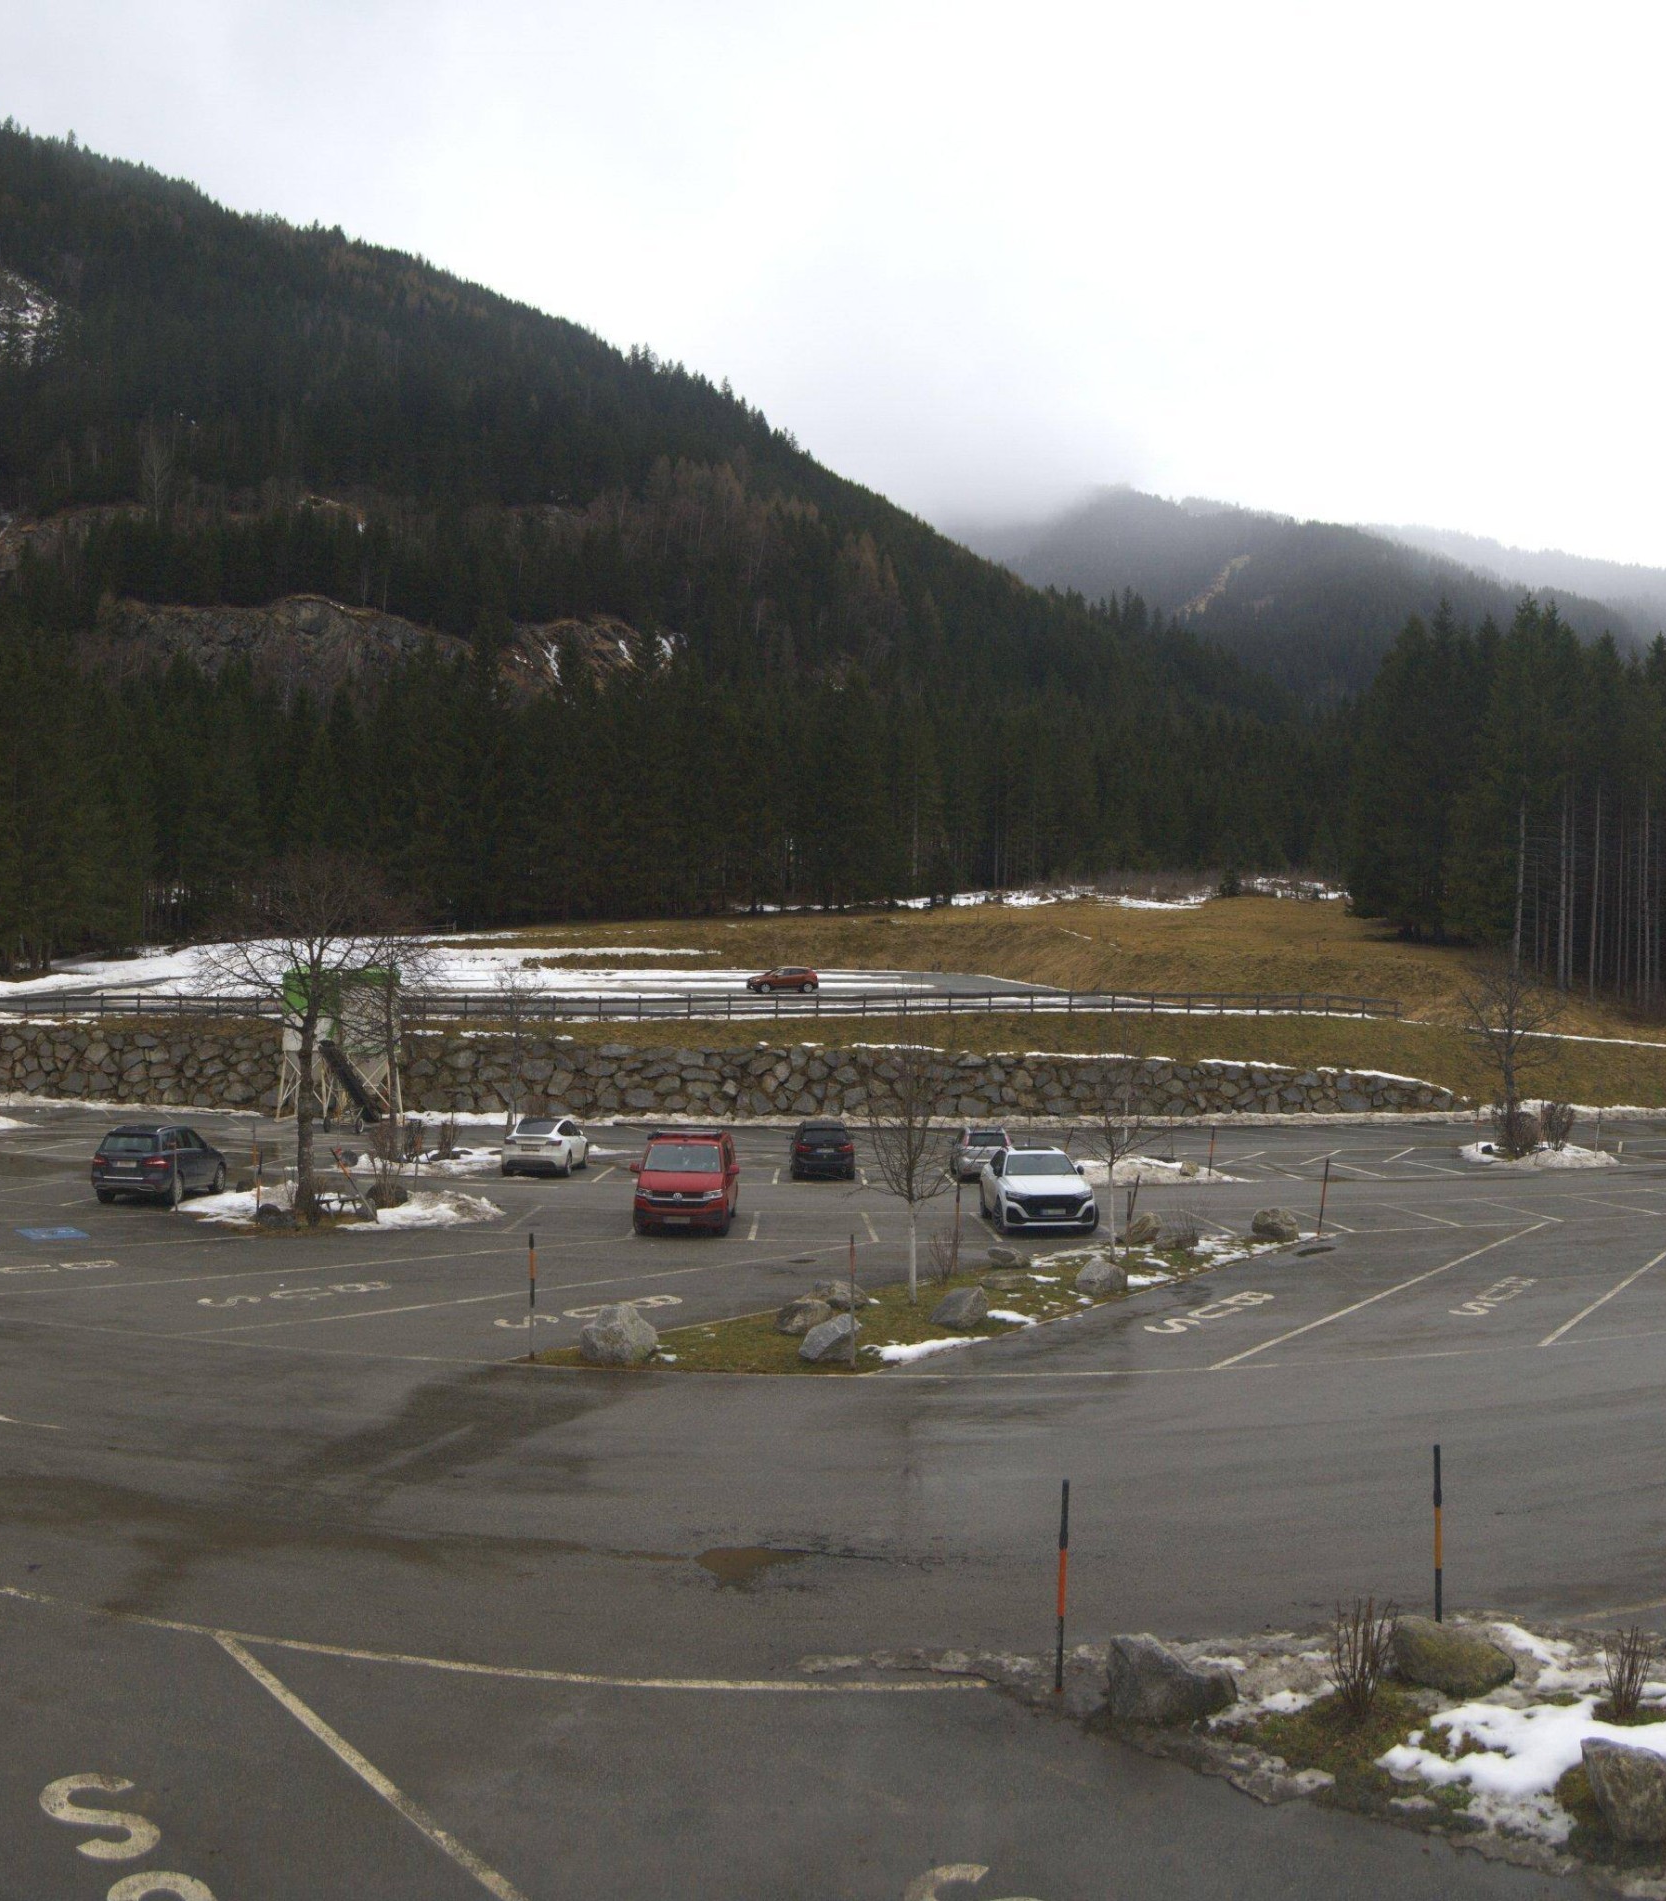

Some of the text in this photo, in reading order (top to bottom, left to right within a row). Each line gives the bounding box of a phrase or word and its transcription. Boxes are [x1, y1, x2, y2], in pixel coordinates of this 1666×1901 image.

[197, 1280, 393, 1308] BUS
[1144, 1291, 1275, 1334] BUS
[1448, 1276, 1538, 1316] BUS
